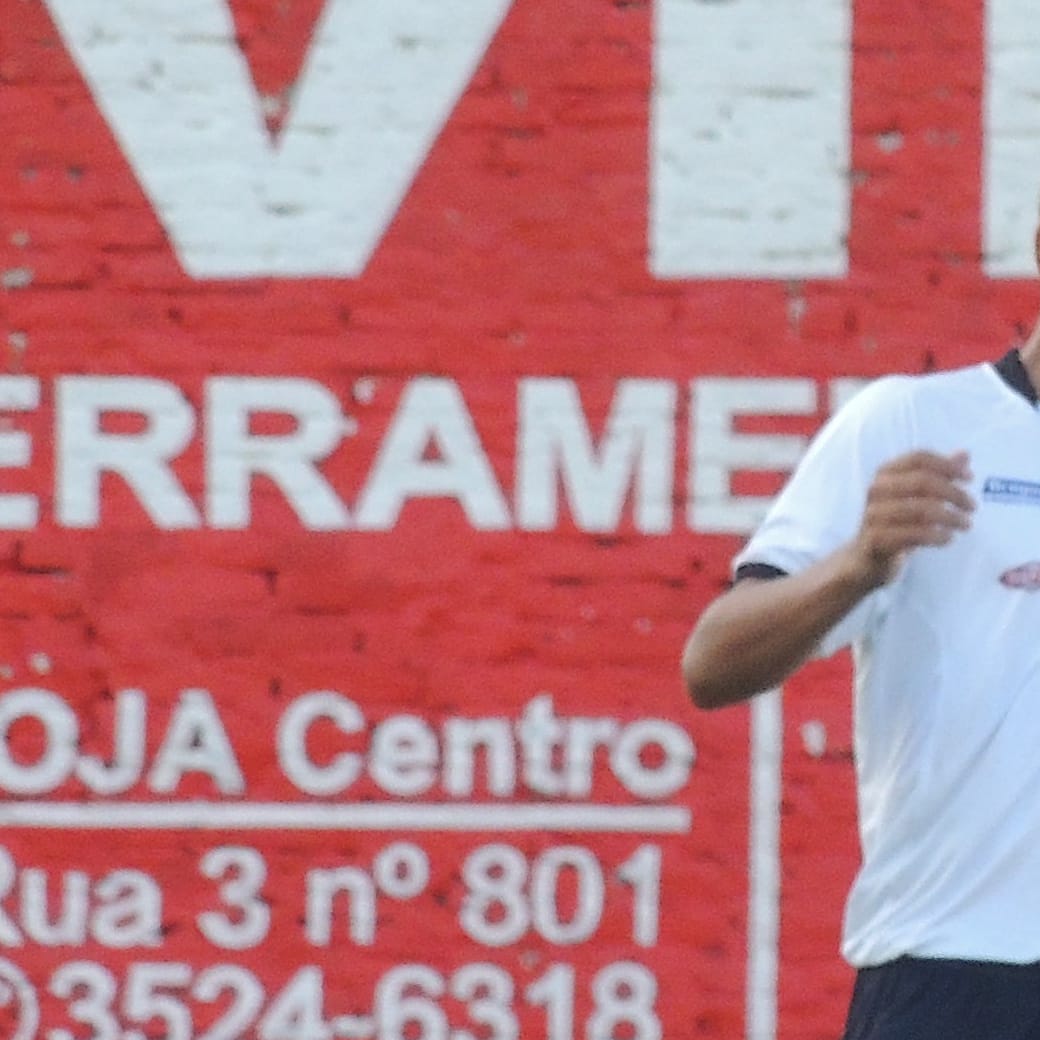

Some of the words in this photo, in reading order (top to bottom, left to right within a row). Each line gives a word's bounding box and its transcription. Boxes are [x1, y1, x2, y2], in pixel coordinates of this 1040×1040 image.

[277, 691, 695, 798] Centro
[198, 846, 270, 950] 3
[460, 844, 662, 947] 801
